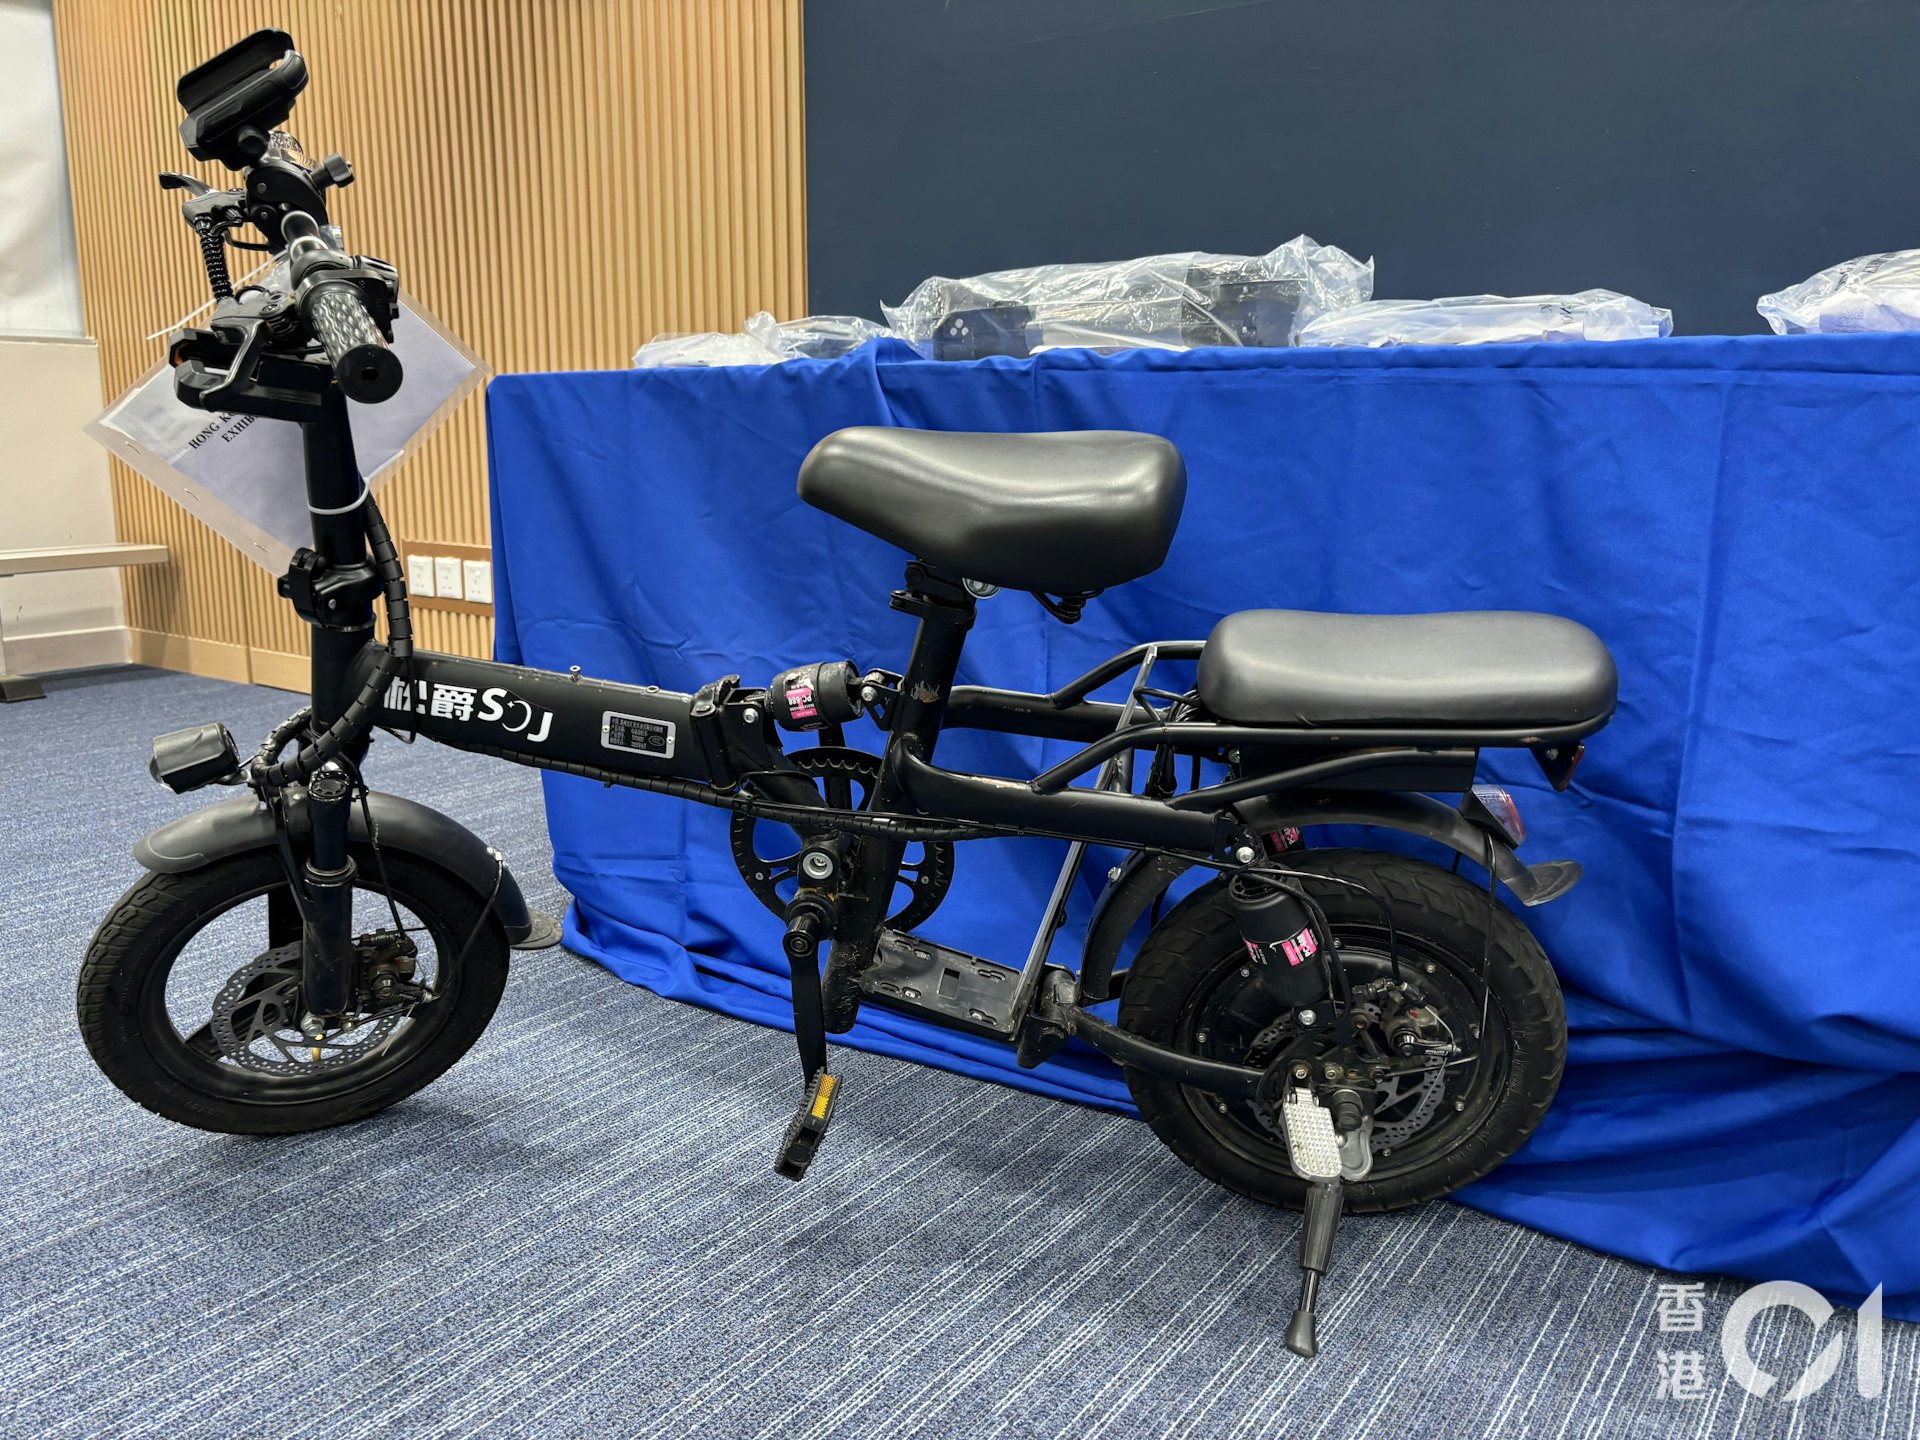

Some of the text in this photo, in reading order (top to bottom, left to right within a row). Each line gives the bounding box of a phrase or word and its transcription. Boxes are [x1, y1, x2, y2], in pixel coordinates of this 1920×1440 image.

[188, 412, 235, 449] HONG K
[221, 415, 258, 443] EXHIB
